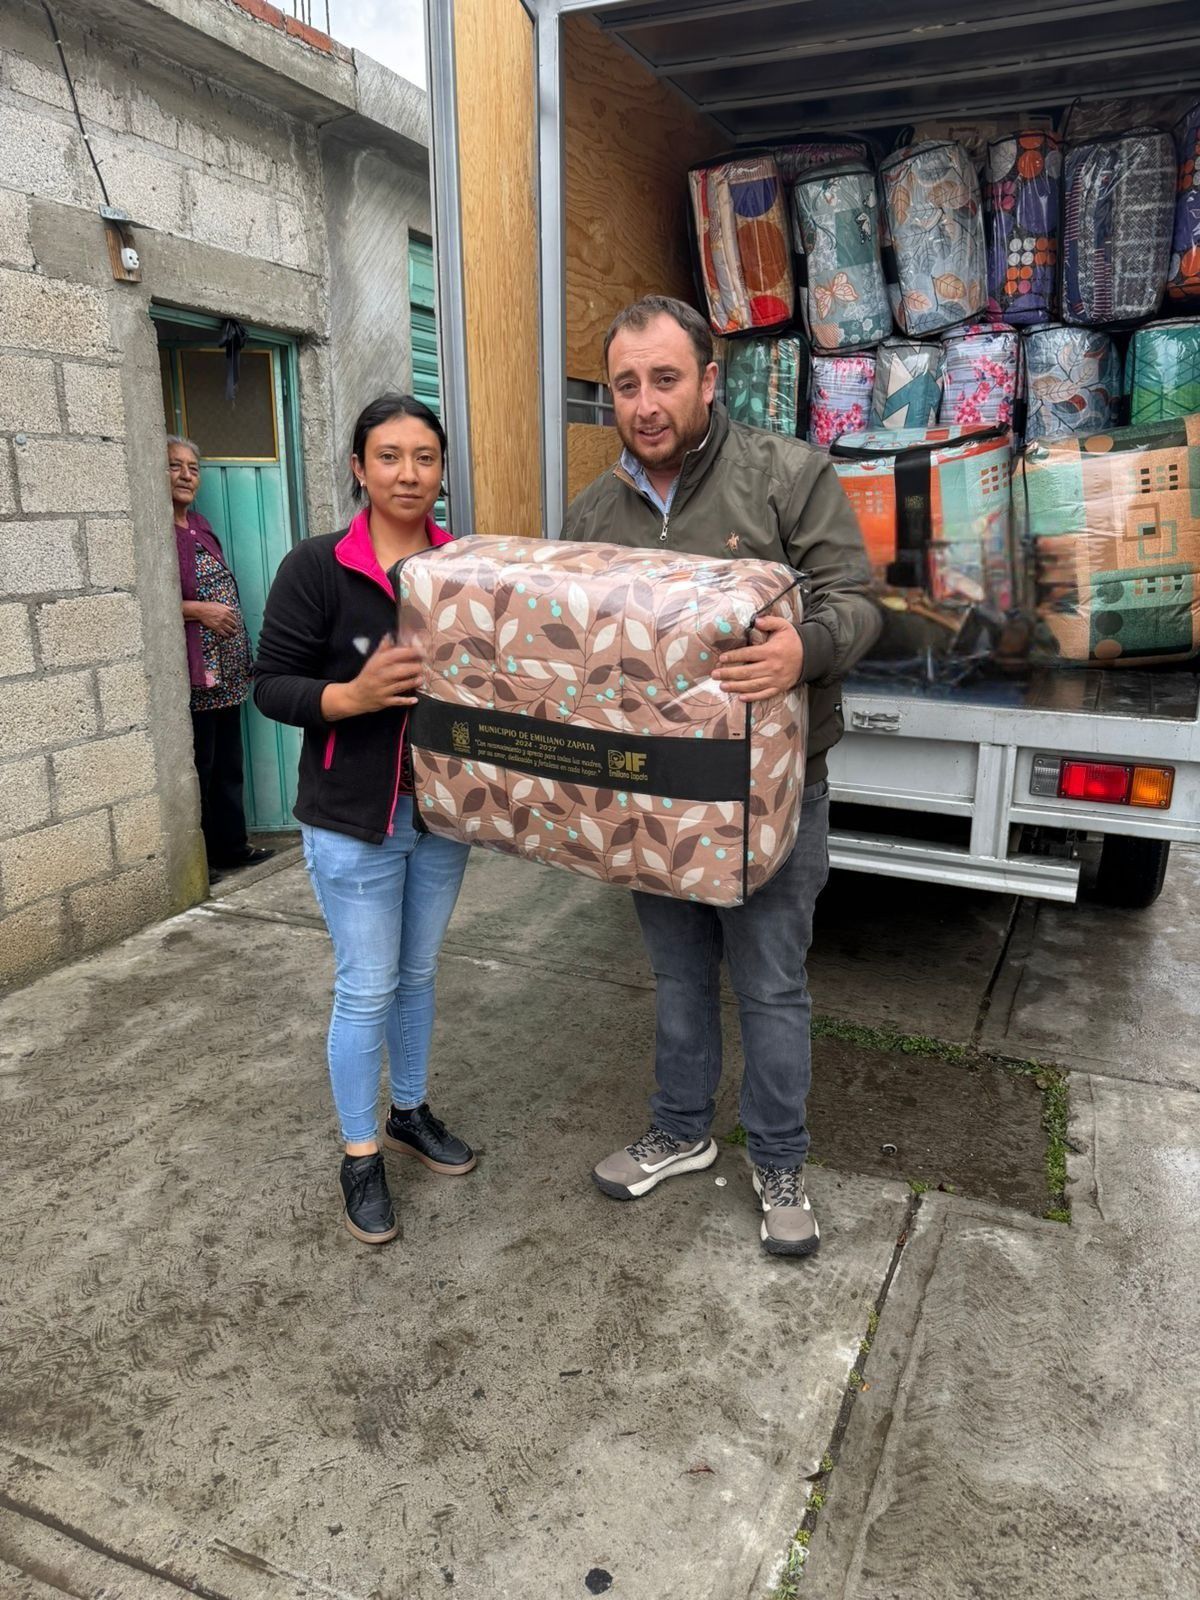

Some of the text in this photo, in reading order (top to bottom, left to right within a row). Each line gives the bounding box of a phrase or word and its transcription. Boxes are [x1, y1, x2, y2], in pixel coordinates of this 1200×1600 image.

[478, 724, 596, 752] MUNICIPIO DE EMILIANO ZAPATA
[539, 744, 557, 752] 2027
[608, 749, 647, 772] DIF
[609, 769, 648, 782] Emiliano Zapata
